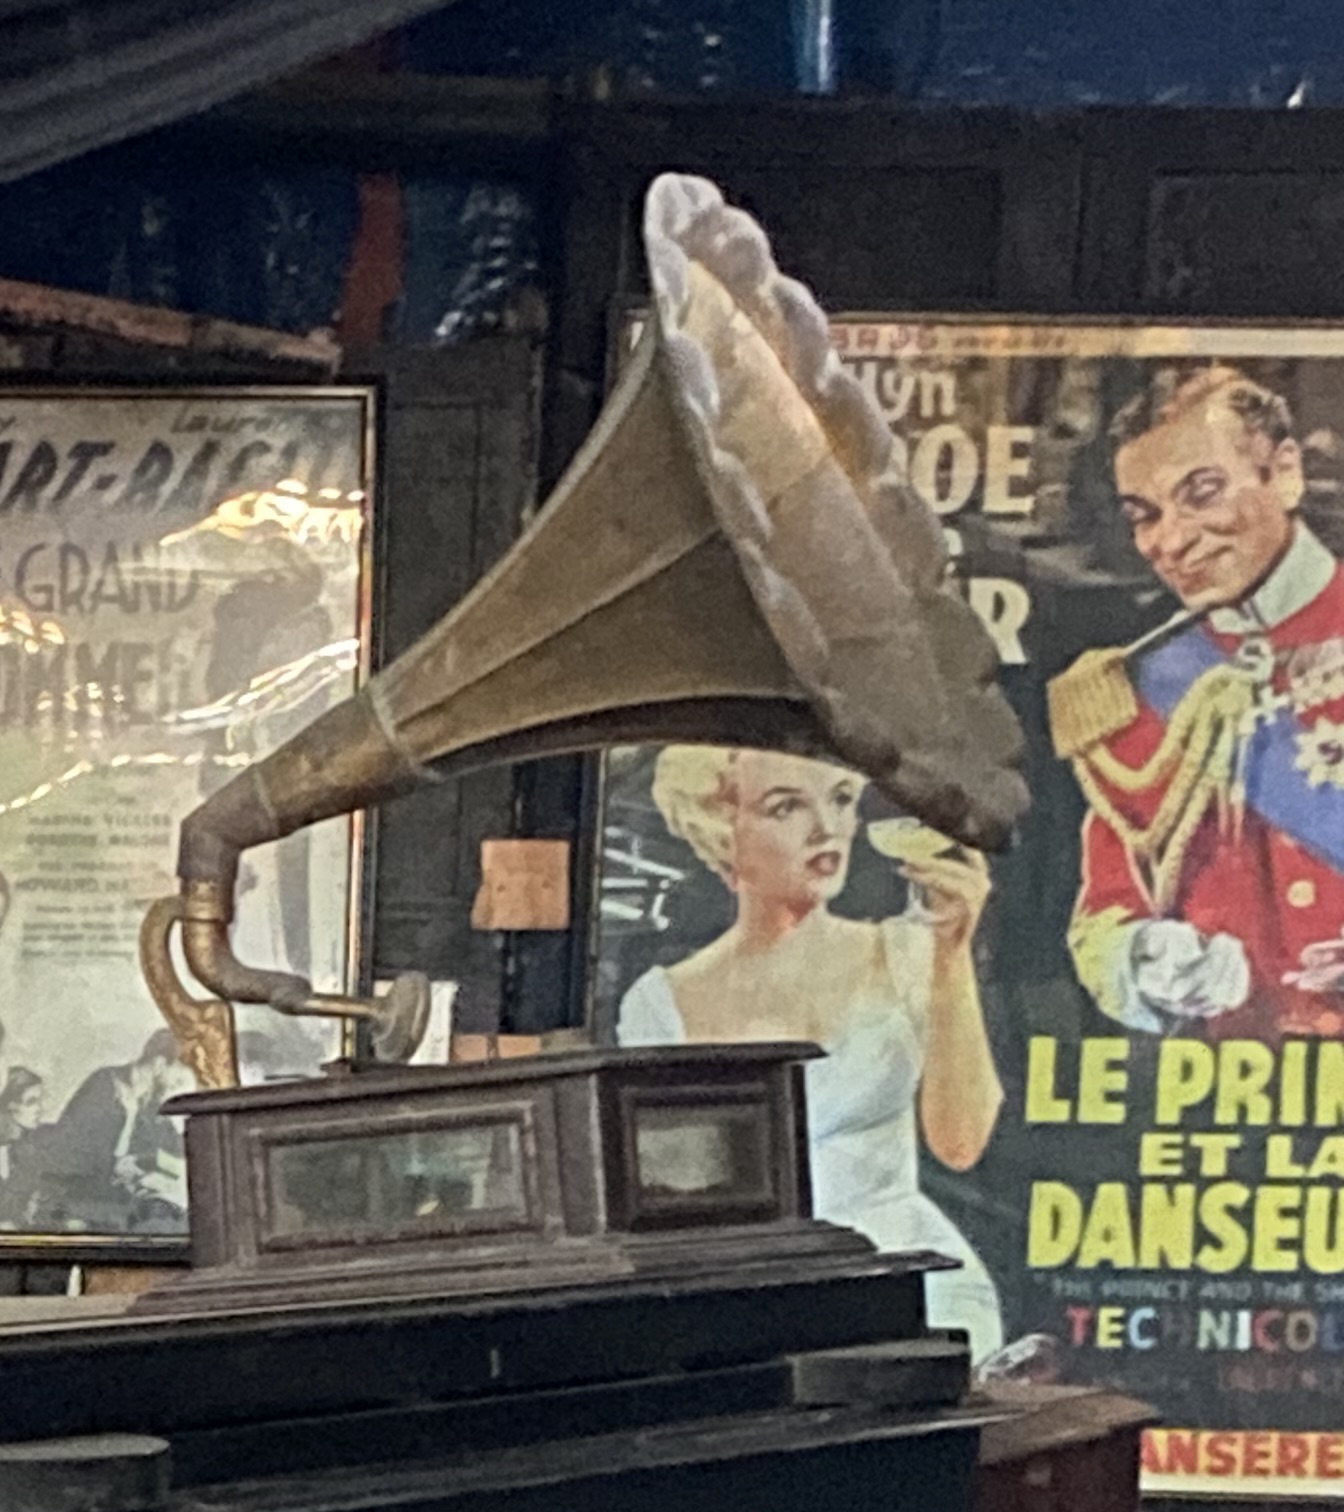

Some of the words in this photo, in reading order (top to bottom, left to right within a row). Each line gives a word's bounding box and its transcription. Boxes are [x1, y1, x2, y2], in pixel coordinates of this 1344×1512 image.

[170, 401, 287, 434] Laure
[893, 424, 1036, 514] OE
[16, 541, 199, 615] GRAND
[1025, 1035, 1130, 1123] LE
[1139, 1132, 1241, 1177] ET
[1265, 1133, 1344, 1178] LA
[1027, 1181, 1344, 1273] DANSEU
